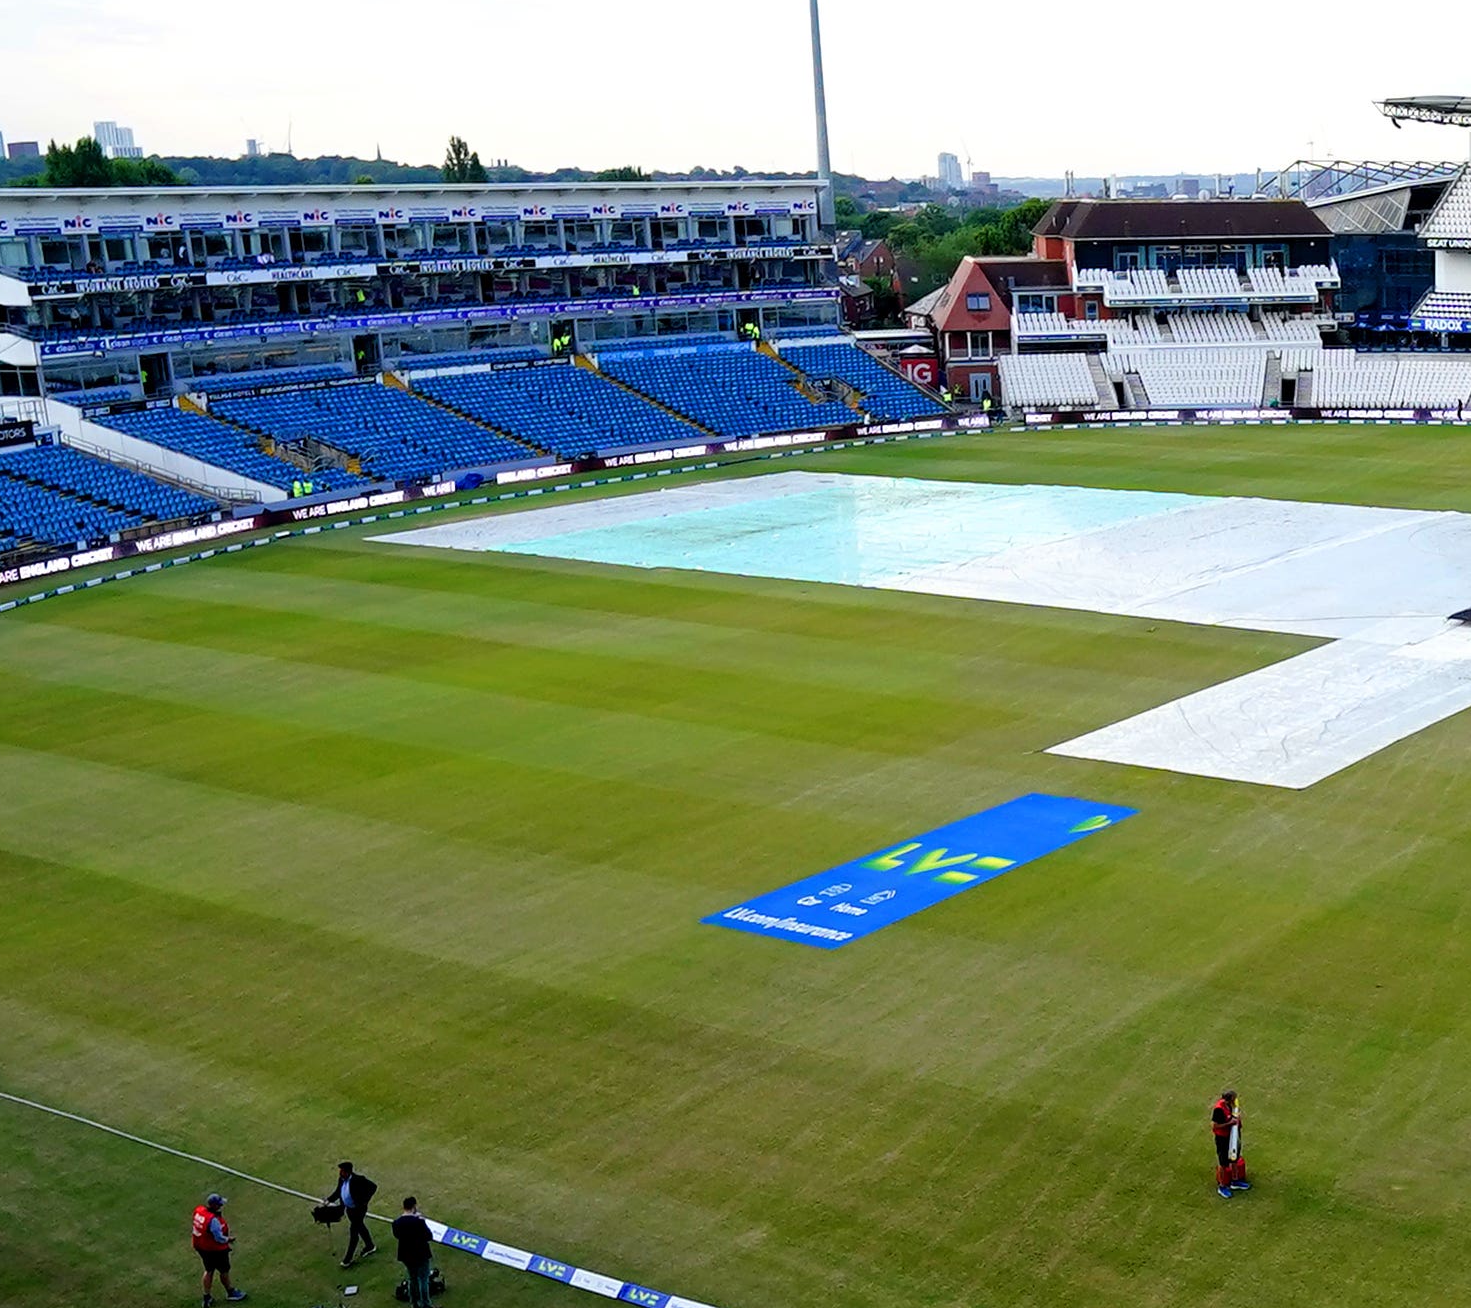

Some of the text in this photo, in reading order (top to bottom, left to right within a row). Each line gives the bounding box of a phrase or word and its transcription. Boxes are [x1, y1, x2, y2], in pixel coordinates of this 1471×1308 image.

[1427, 240, 1447, 248] SEAT
[1425, 319, 1463, 332] RADOX
[907, 363, 932, 384] IG
[19, 556, 71, 578] ENGLAND
[70, 547, 114, 568] CRICKET
